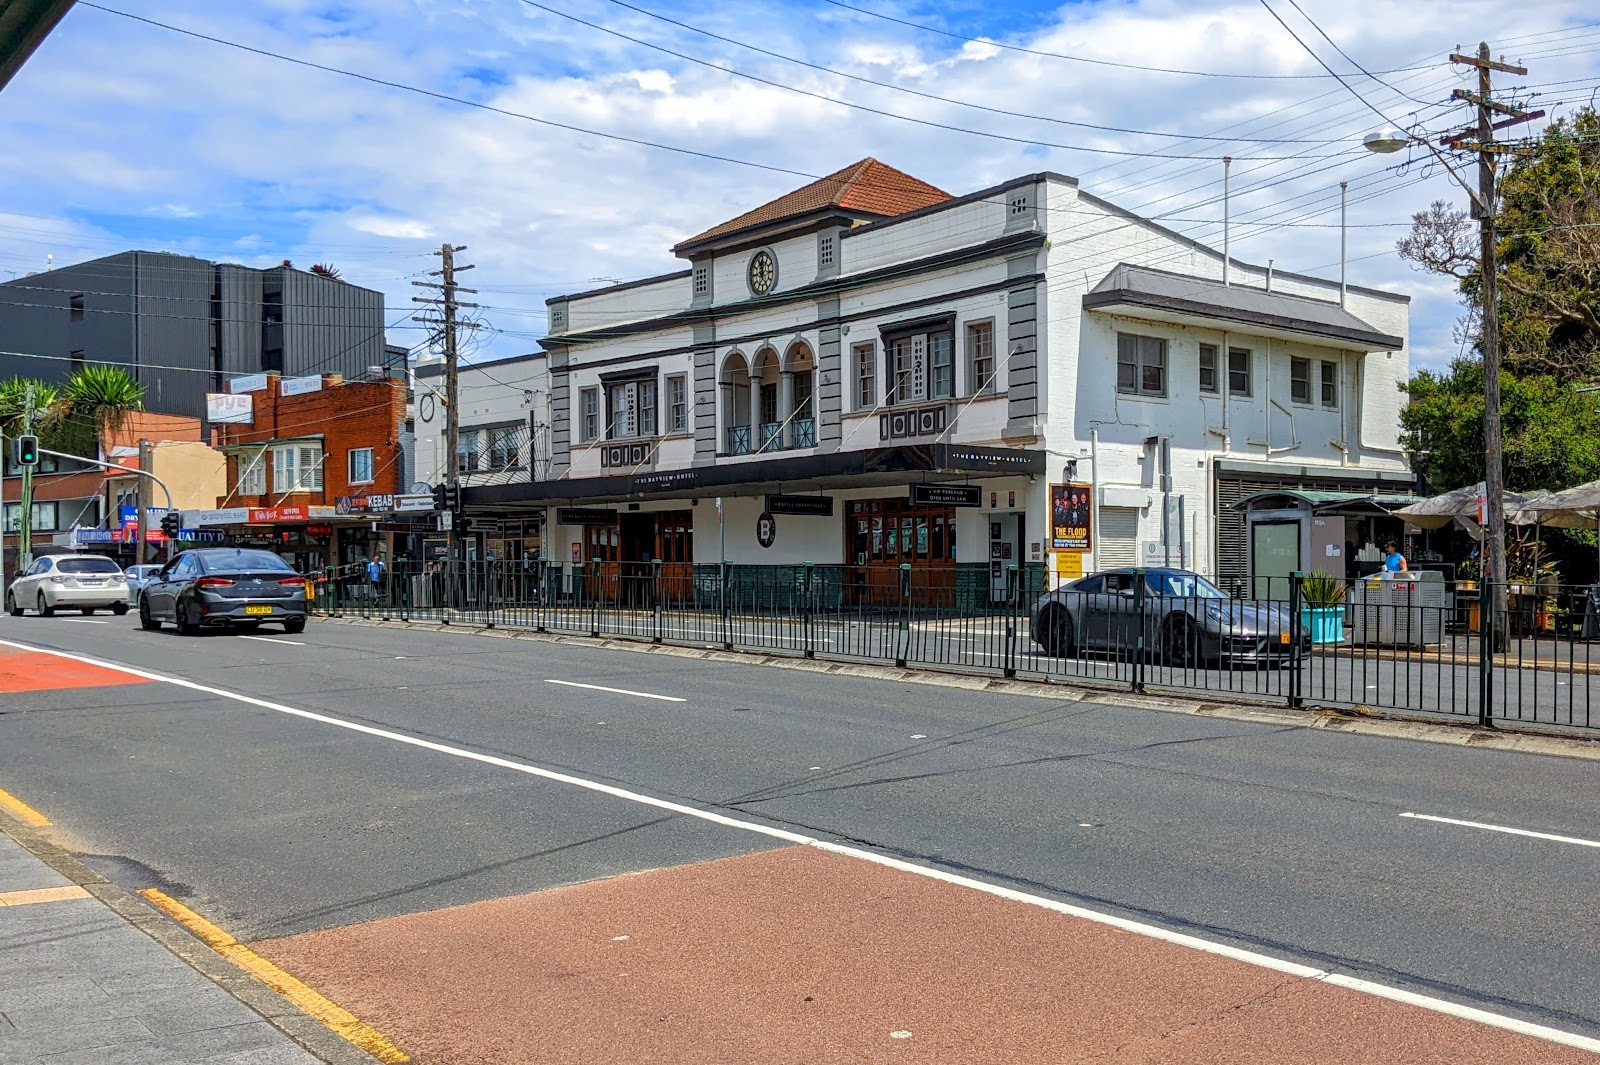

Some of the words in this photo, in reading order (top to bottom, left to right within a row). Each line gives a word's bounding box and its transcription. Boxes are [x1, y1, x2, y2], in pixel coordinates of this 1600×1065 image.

[368, 495, 392, 507] KEBAB
[1055, 527, 1066, 536] THE
[1068, 528, 1087, 536] FLOOD
